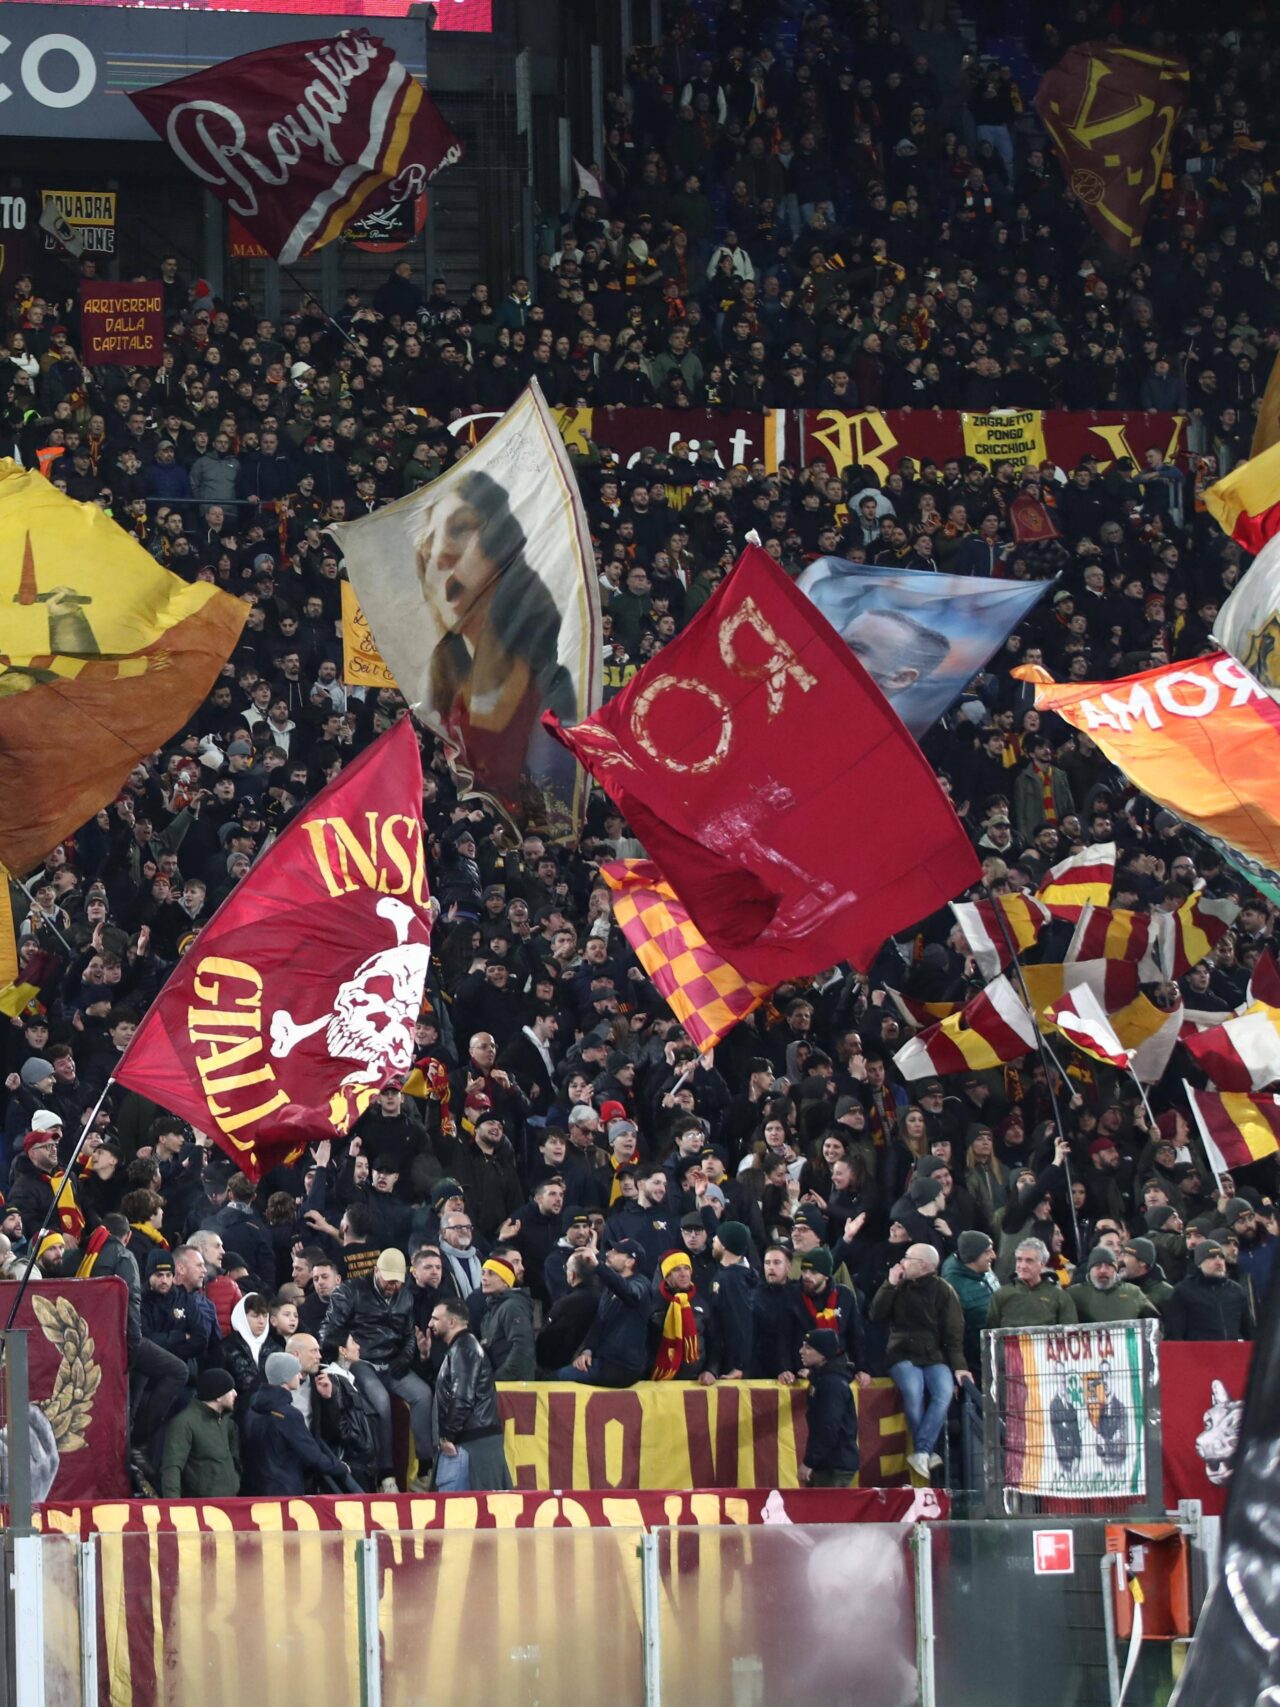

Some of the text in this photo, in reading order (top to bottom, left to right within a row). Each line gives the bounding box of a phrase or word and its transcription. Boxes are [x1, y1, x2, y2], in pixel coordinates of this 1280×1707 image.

[104, 317, 146, 333] DALLA
[92, 334, 154, 352] CAPITALE
[987, 427, 1024, 442] PONGO
